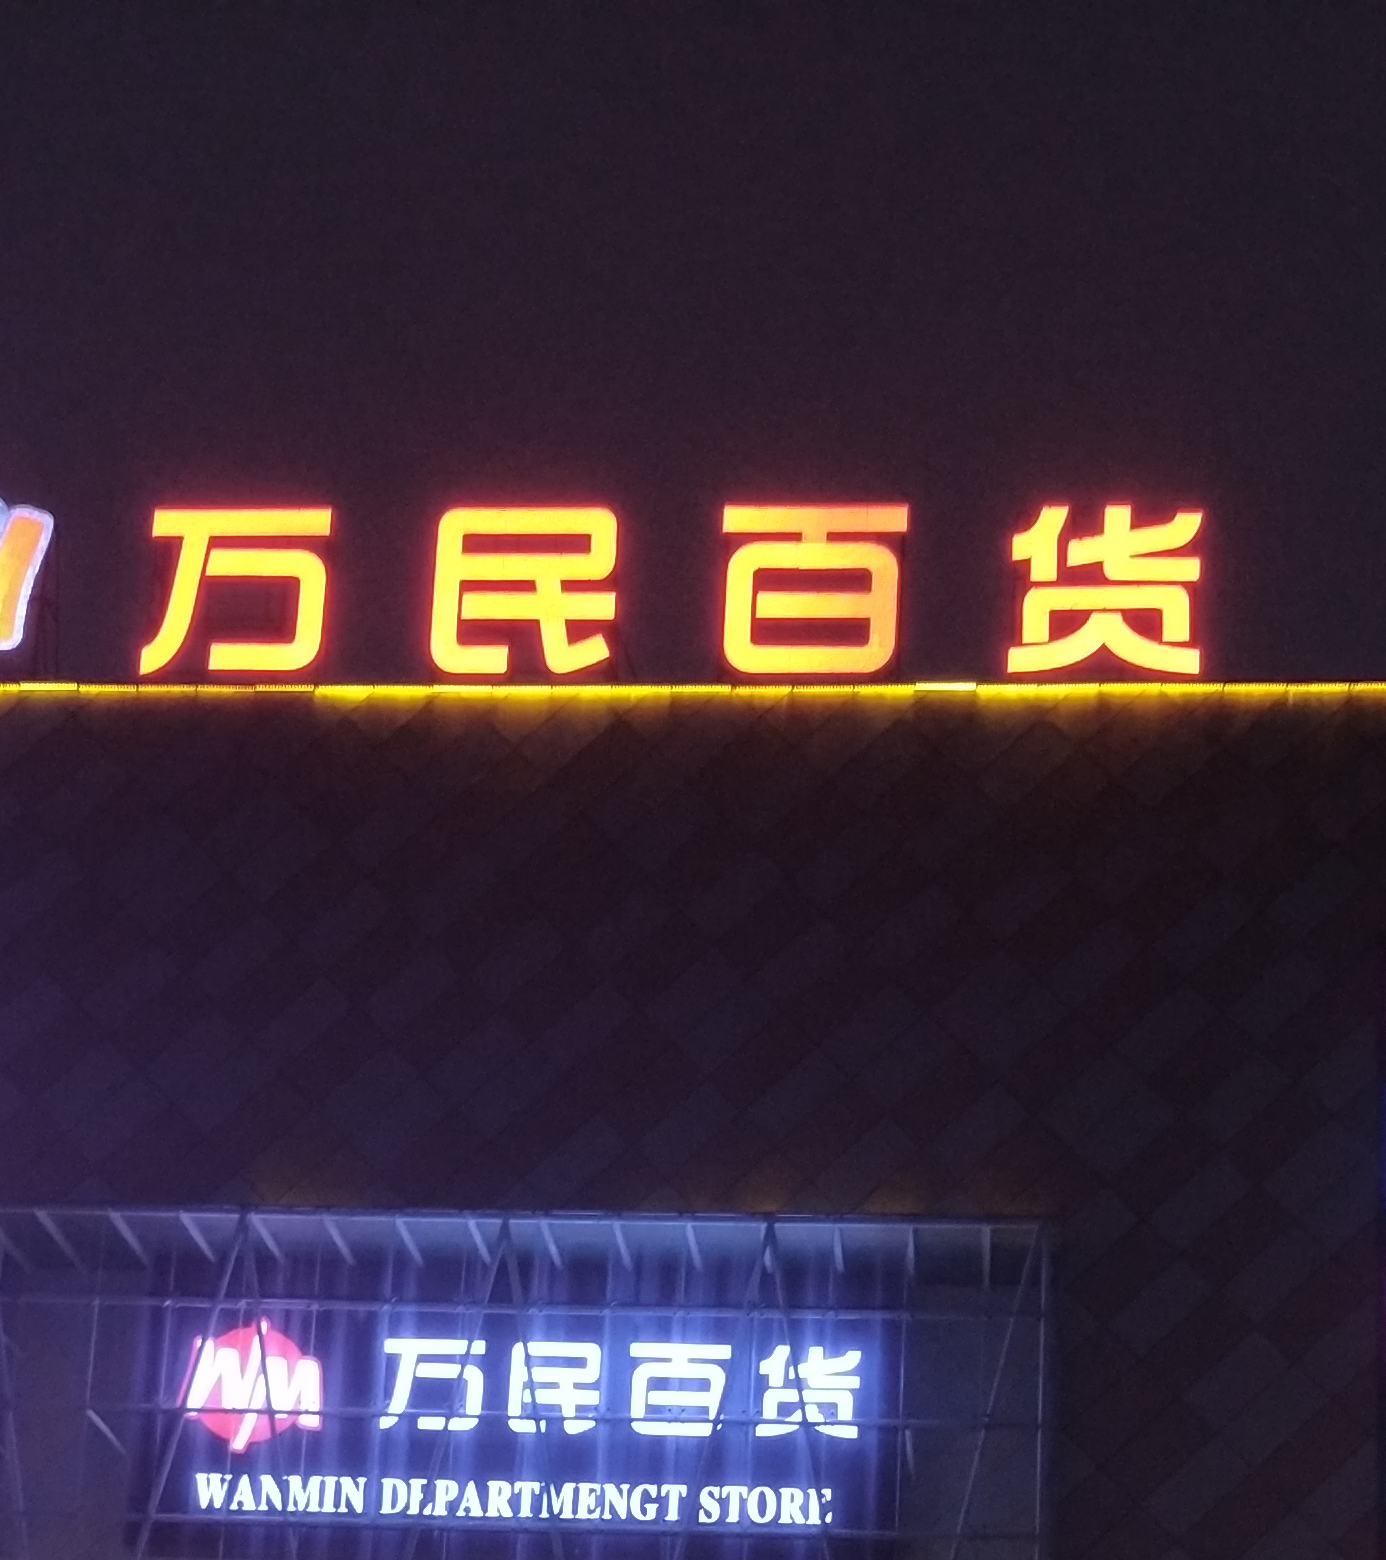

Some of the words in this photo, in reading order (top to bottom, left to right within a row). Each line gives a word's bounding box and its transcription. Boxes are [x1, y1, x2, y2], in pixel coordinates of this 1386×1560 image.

[138, 502, 1204, 676] 万民百货
[379, 1338, 862, 1440] 万民百货
[195, 1472, 368, 1515] WANMIN
